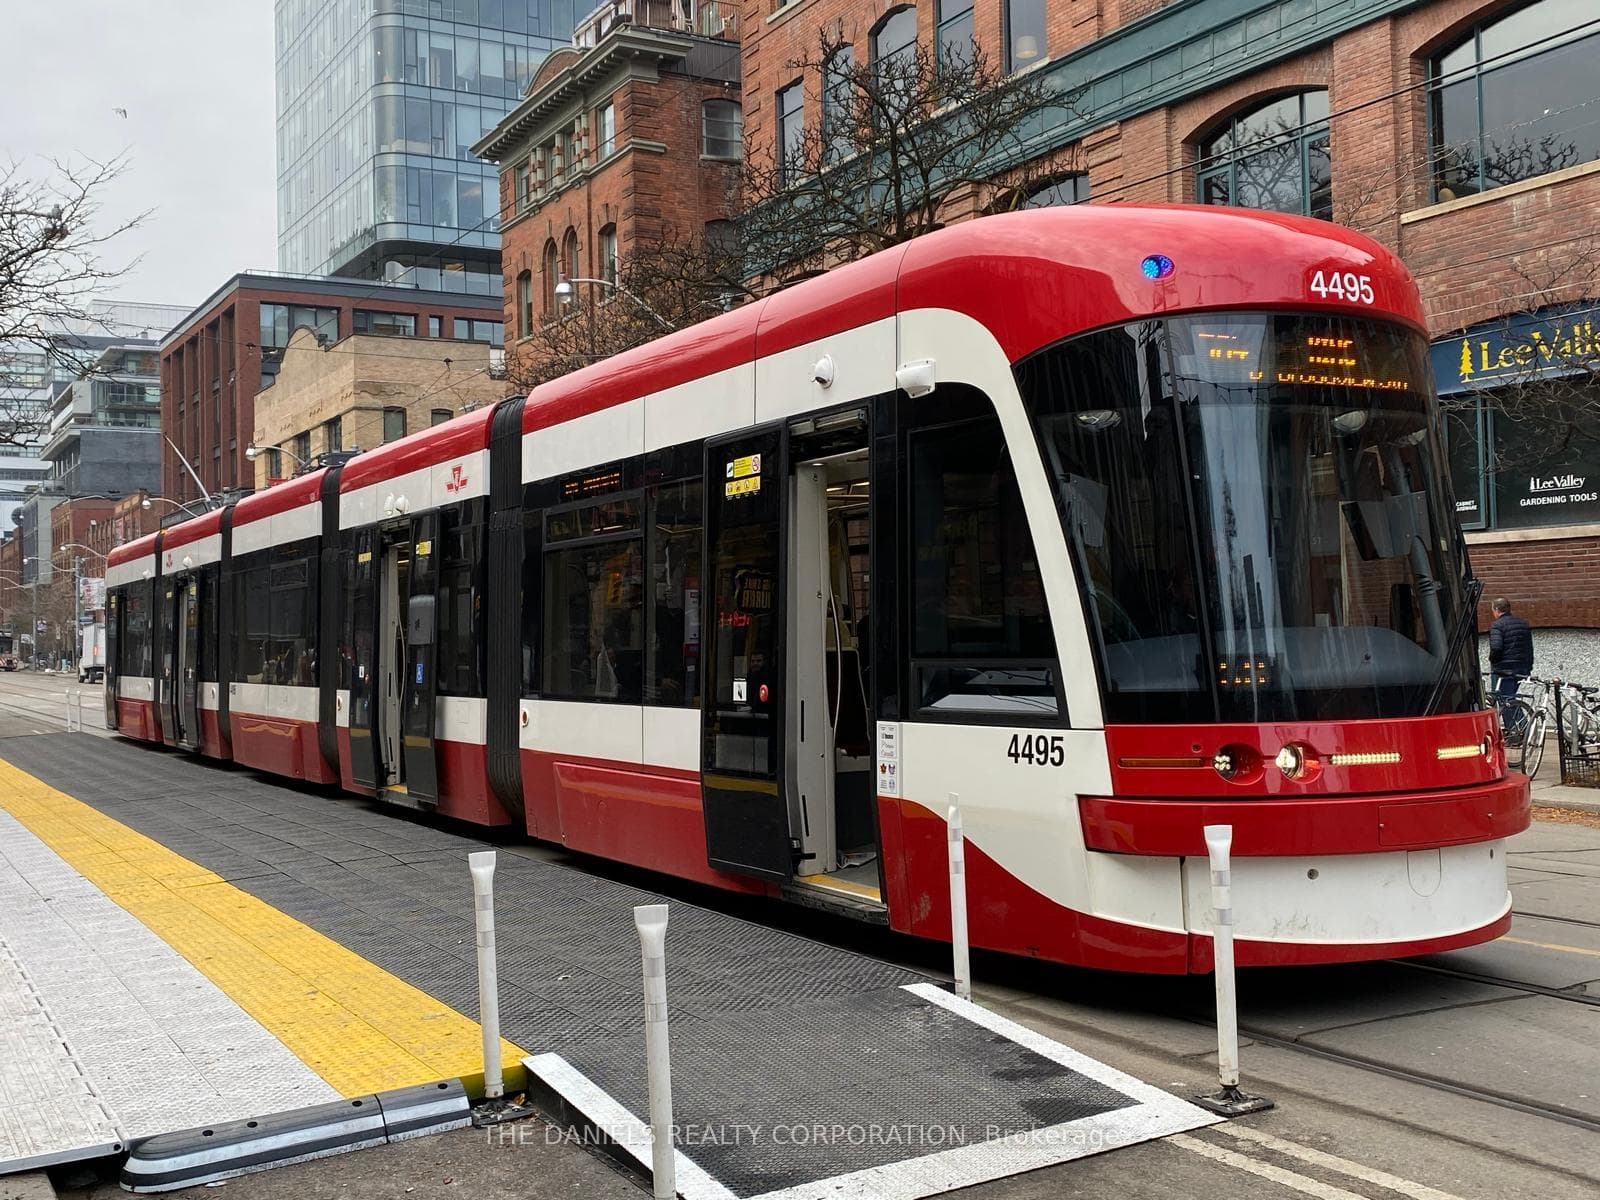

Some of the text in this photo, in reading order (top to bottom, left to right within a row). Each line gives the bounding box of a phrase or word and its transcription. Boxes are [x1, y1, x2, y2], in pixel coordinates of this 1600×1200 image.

[1310, 270, 1375, 304] 4495
[1480, 341, 1532, 371] Lee
[1536, 474, 1586, 489] Lee Valley
[1520, 492, 1598, 507] GARDENING TOOLS
[1007, 734, 1065, 767] 4495
